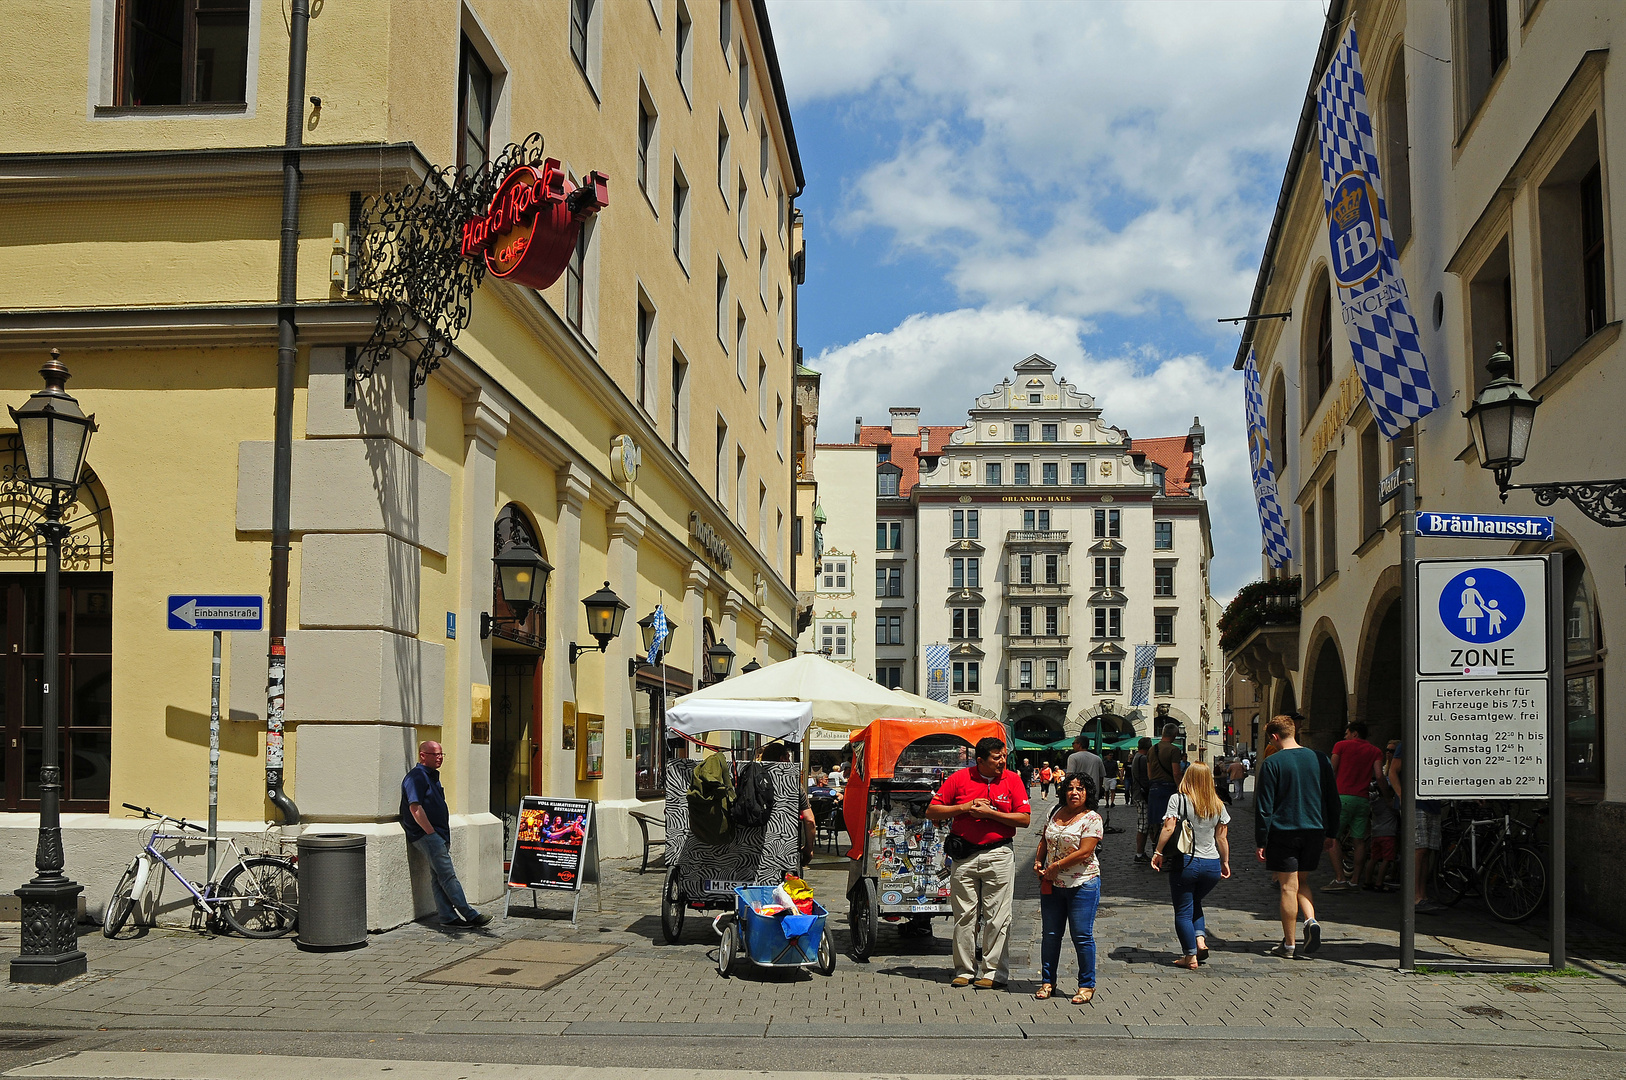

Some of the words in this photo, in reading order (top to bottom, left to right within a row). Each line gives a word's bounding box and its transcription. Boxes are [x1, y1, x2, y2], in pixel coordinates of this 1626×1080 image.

[461, 196, 506, 255] Hard
[509, 163, 553, 225] Rock
[1336, 220, 1376, 275] HB
[1341, 278, 1408, 325] ÜNCHEN
[1381, 470, 1400, 498] Platzl
[1430, 514, 1542, 536] Bräuhausstr.
[194, 608, 257, 617] Einbahnstraße
[1450, 648, 1515, 667] ZONE
[1436, 688, 1511, 698] Lieferverkehr
[1514, 687, 1530, 696] für
[1432, 700, 1489, 711] Fahrzeuge
[1492, 700, 1508, 709] bis
[1531, 700, 1535, 708] t
[1427, 712, 1447, 722] zul.
[1450, 712, 1516, 723] Gesamtgew.
[1520, 711, 1539, 720] frei
[1444, 732, 1489, 743] Sonntag
[1517, 732, 1524, 740] h
[1528, 732, 1544, 740] bis
[1444, 744, 1492, 755] Samstag
[1517, 744, 1524, 753] h
[1423, 756, 1459, 768] täglich
[1536, 755, 1543, 764] h
[1420, 778, 1434, 786] an
[1437, 777, 1496, 788] Feiertagen
[1499, 776, 1512, 785] ab
[1538, 776, 1545, 785] h
[712, 881, 720, 890] M
[723, 882, 737, 891] RS
